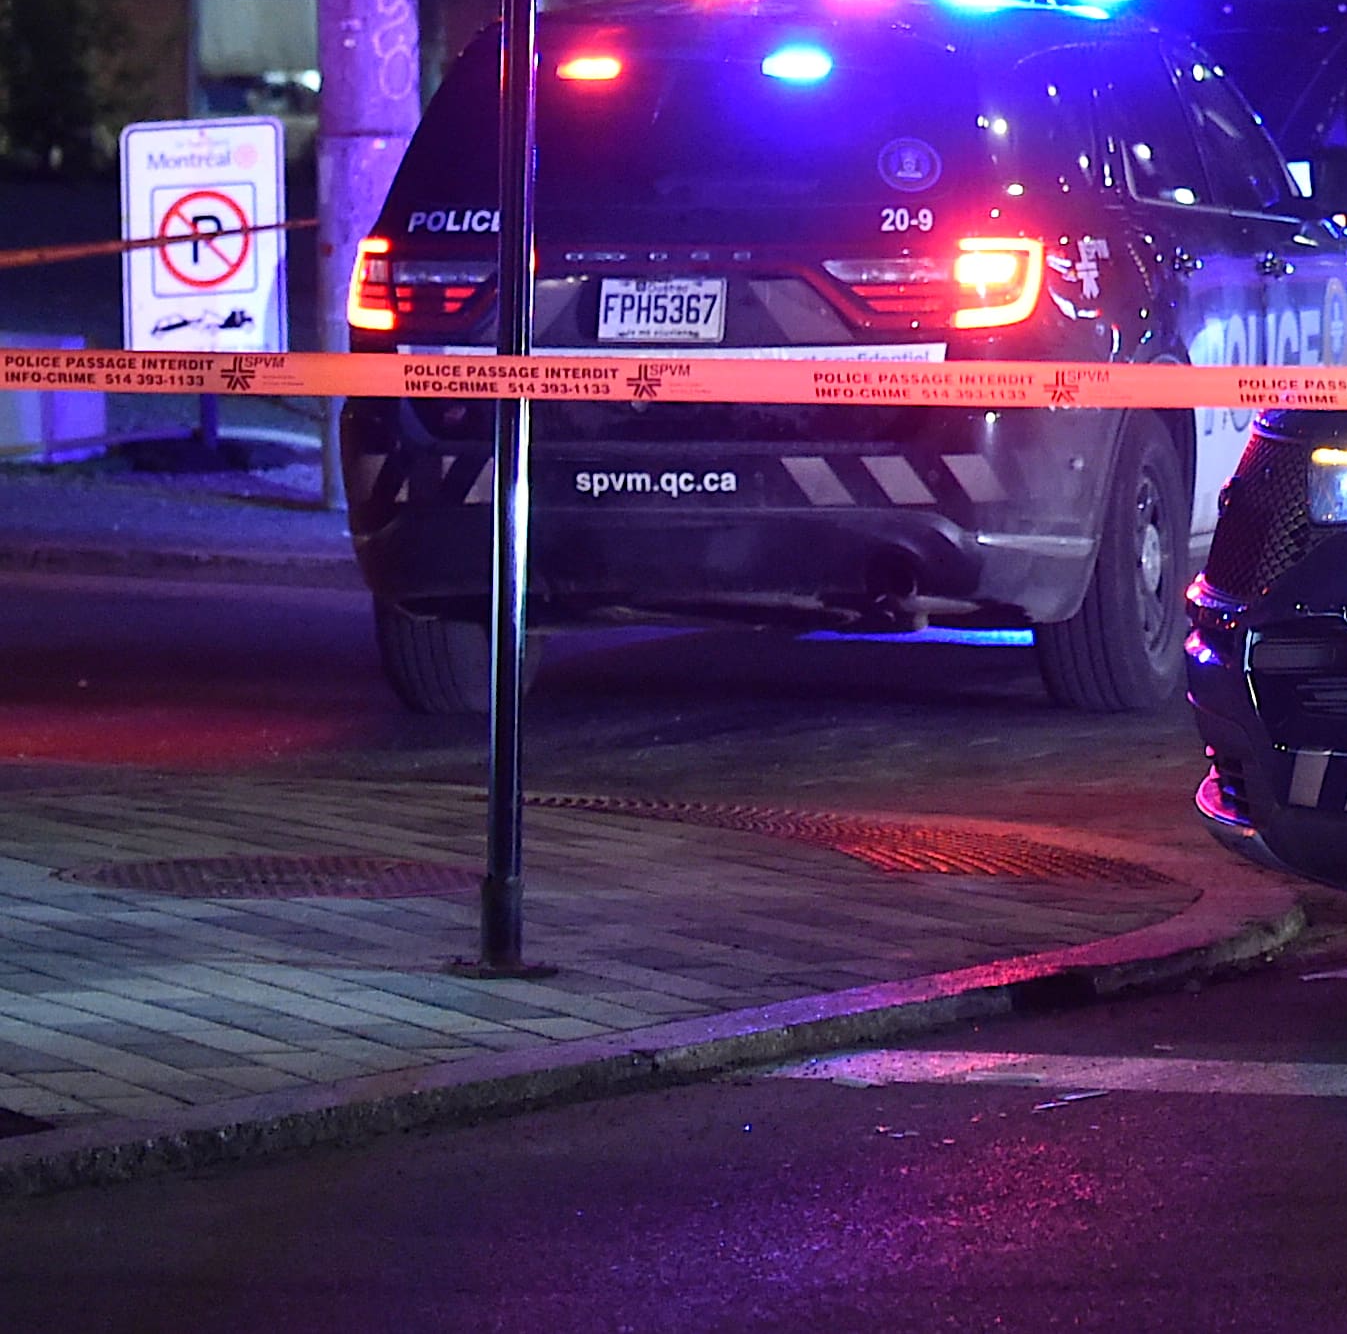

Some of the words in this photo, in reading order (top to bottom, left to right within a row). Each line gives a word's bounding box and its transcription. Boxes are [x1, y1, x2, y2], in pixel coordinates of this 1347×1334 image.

[147, 151, 231, 170] Montréal
[880, 208, 933, 231] 20-9
[603, 294, 718, 325] FPH5367
[5, 356, 60, 368] POLICE
[66, 356, 137, 369] PASSAGE
[142, 358, 215, 371] INTERDIT
[244, 356, 285, 368] SPVM
[404, 364, 461, 377] POLICE
[467, 365, 539, 378] PASSAGE
[545, 367, 619, 379] INTERDIT
[650, 363, 690, 377] SPVM
[1067, 370, 1110, 383] SPVM
[5, 372, 96, 384] INFO-CRIME
[106, 373, 131, 385] 514
[137, 374, 204, 386] 393-1133
[813, 372, 869, 384] POLICE
[878, 373, 950, 386] PASSAGE
[959, 374, 1035, 386] INTERDIT
[1238, 378, 1298, 390] POLICE
[405, 381, 498, 392] INFO-CRIME
[508, 382, 535, 394] 514
[541, 383, 610, 395] 393-1133
[574, 468, 737, 495] spvm.qc.ca
